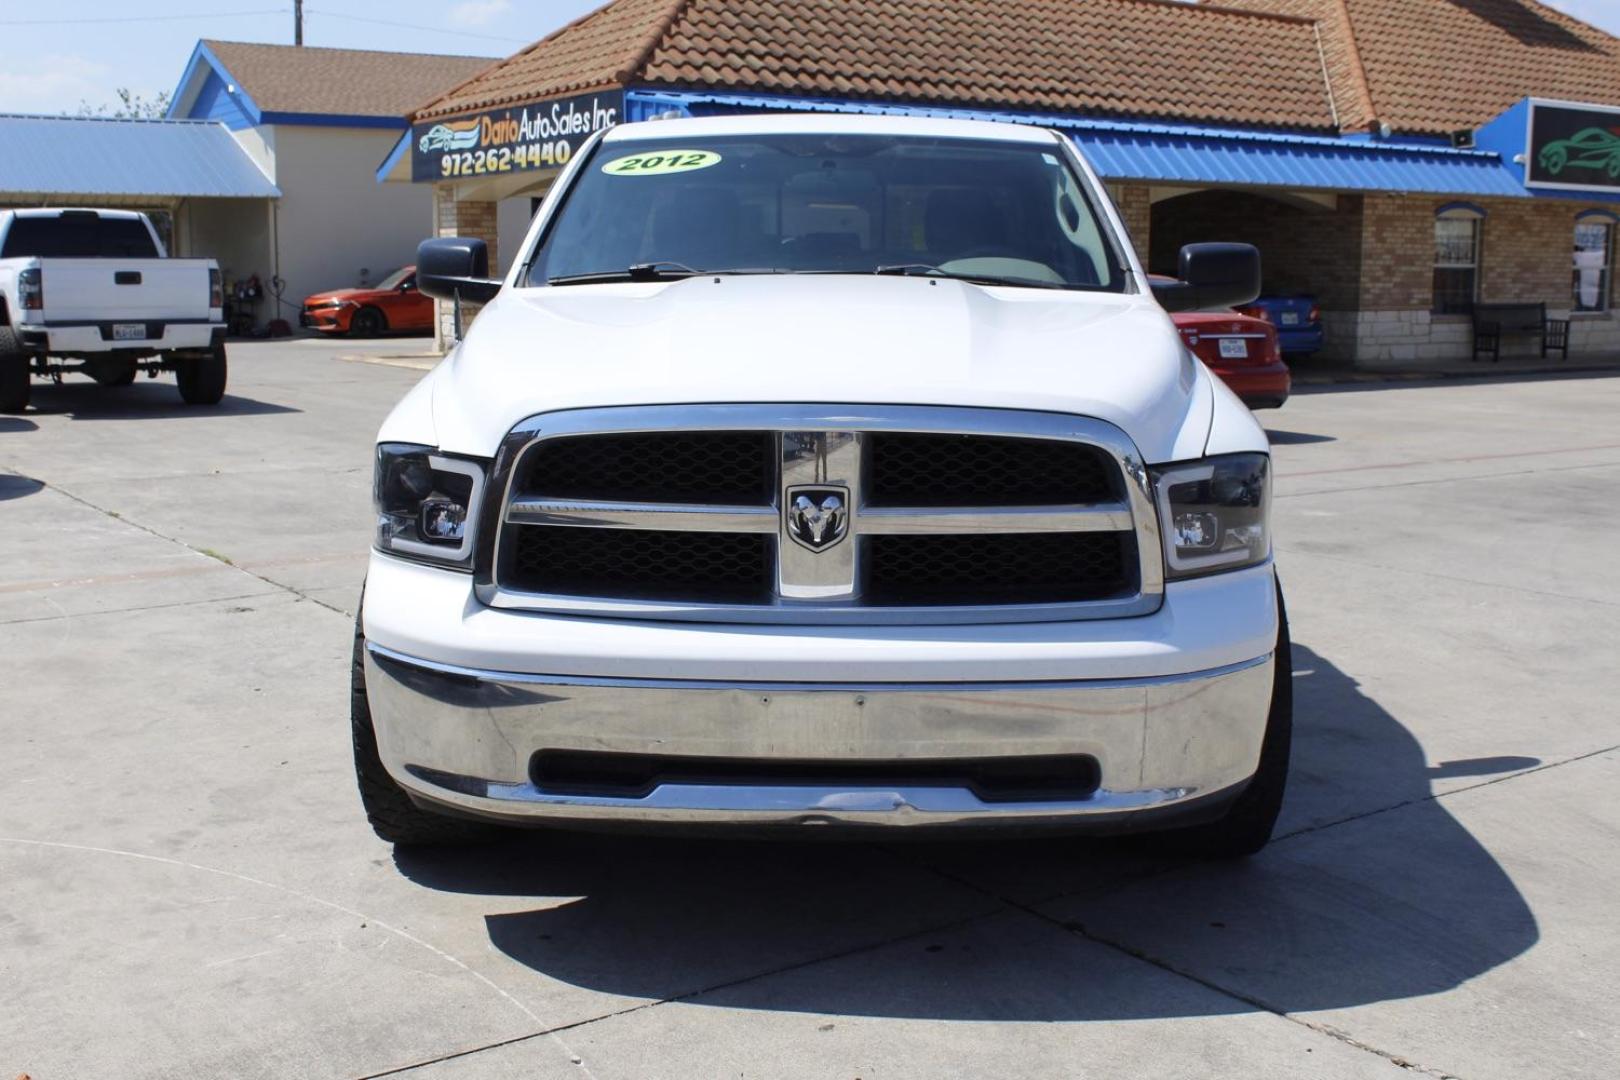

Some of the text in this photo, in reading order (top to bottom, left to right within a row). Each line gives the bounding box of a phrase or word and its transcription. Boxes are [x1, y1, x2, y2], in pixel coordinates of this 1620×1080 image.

[481, 112, 519, 147] Dario
[592, 98, 616, 131] Inc
[616, 154, 706, 172] 2012
